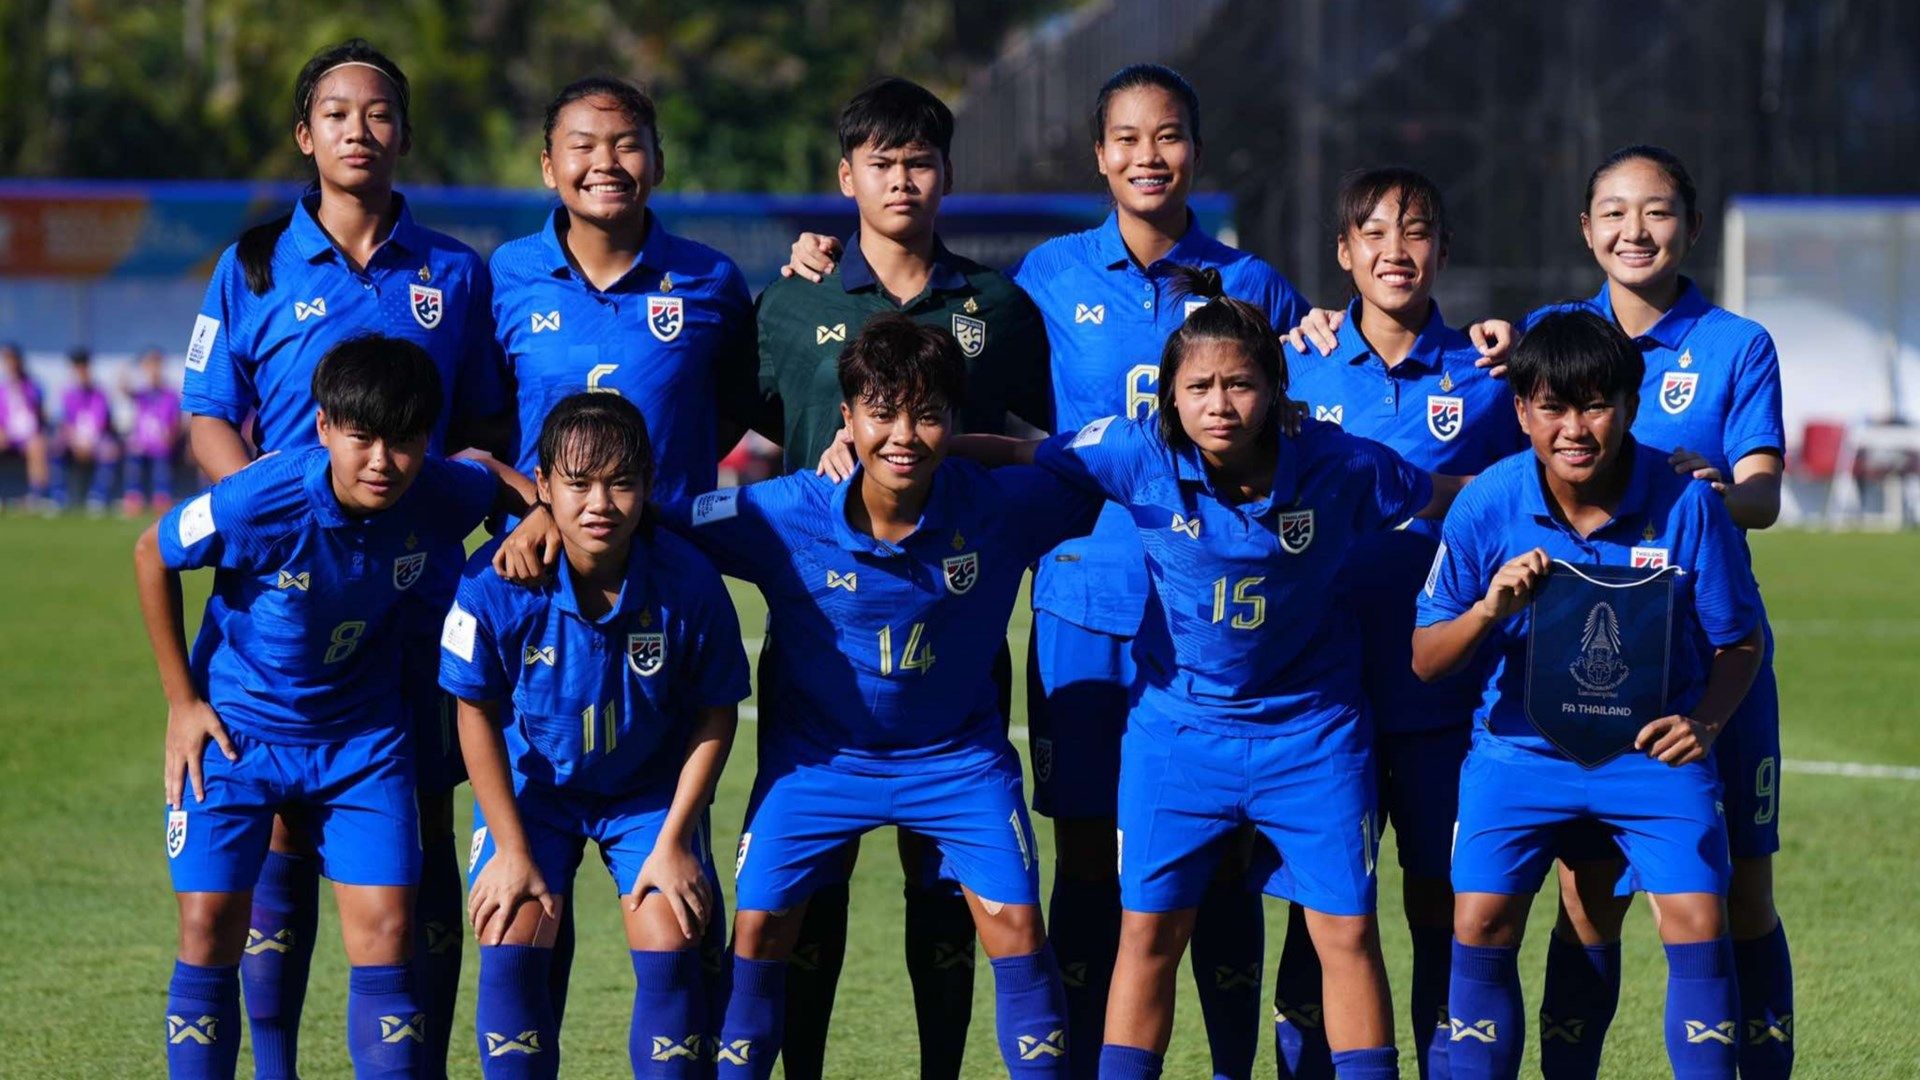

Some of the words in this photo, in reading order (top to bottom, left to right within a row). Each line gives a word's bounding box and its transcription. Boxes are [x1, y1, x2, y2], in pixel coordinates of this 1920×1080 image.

[1126, 364, 1160, 419] 6
[947, 555, 974, 565] THAILAND
[1211, 576, 1266, 630] 15
[323, 620, 367, 665] 8
[876, 622, 936, 676] 14
[580, 699, 617, 755] 11
[1562, 703, 1576, 713] FA
[1578, 704, 1632, 716] THAILAND
[1754, 756, 1775, 825] 9
